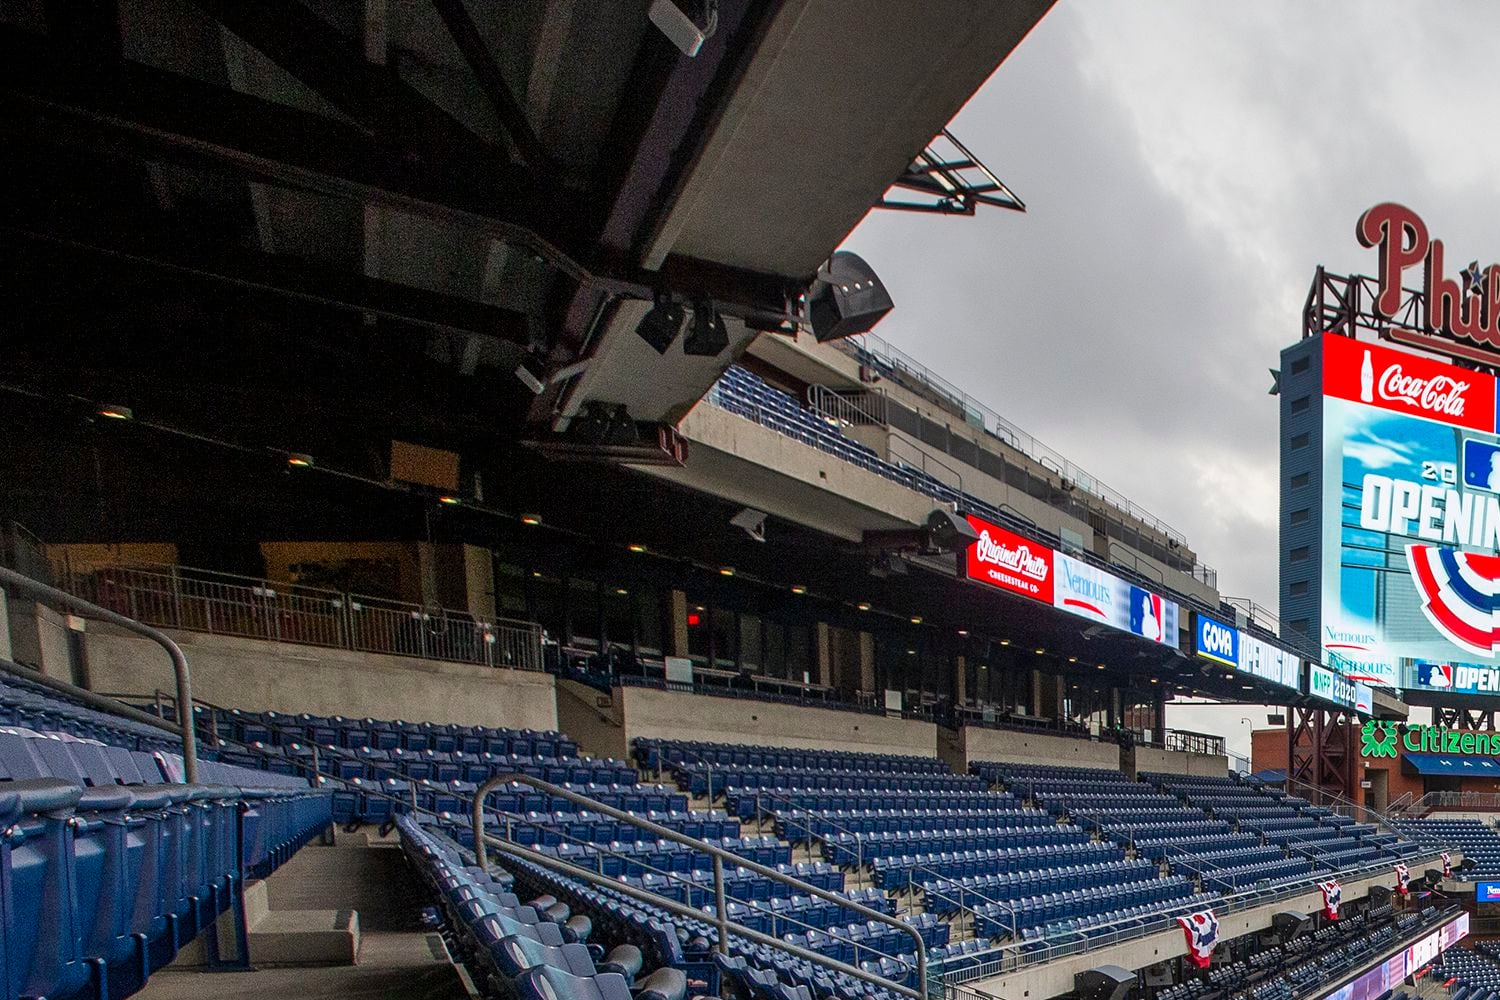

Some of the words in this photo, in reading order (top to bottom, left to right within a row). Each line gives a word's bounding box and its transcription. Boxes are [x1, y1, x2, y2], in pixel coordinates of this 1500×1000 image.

[1378, 364, 1470, 417] Coca-Cola
[977, 530, 1022, 573] Original
[1017, 545, 1048, 581] Philly
[1203, 621, 1233, 657] GOYA
[1238, 633, 1282, 684] OPENING
[1334, 679, 1356, 703] 2020
[1403, 723, 1500, 756] Citizens
